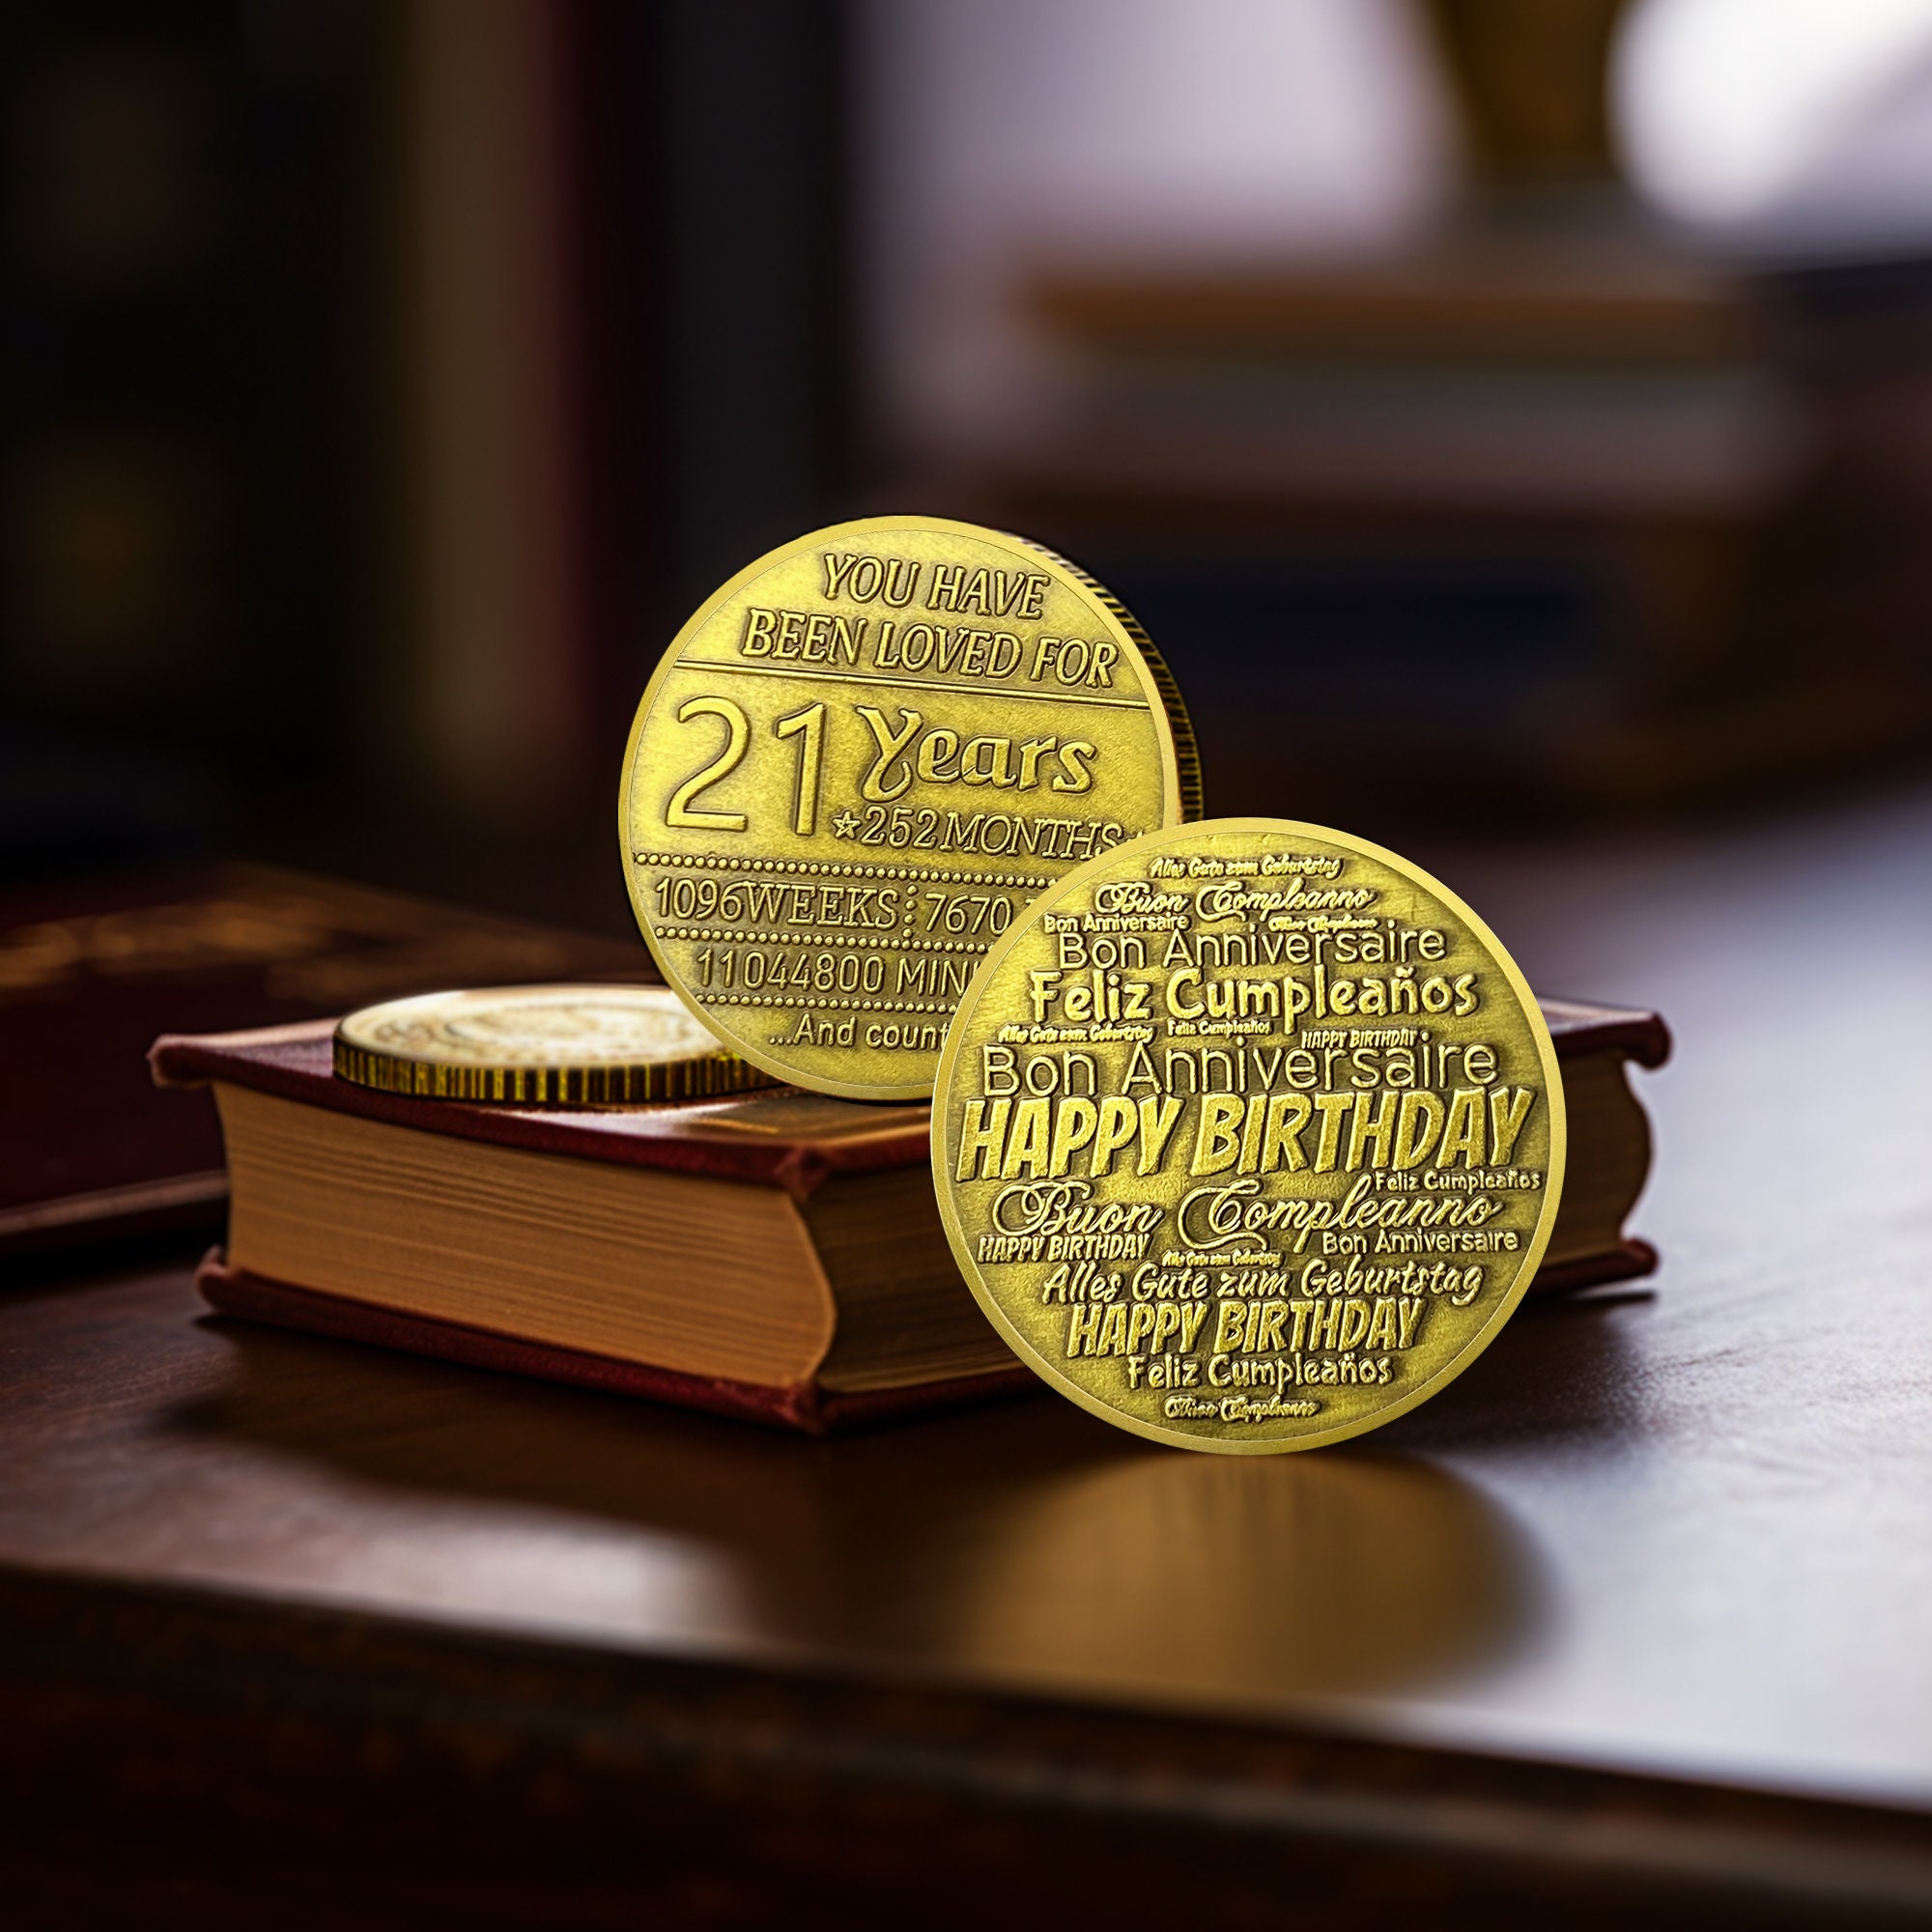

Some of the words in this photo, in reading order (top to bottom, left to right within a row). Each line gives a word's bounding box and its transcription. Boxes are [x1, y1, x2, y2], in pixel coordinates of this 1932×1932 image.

[824, 554, 921, 607] YOU
[928, 565, 1050, 619] HAVE
[743, 609, 867, 667] BEEN
[875, 623, 1025, 679] LOVED
[1030, 638, 1120, 689] FOR
[667, 695, 826, 837] 21
[856, 705, 1095, 802] Years
[925, 893, 1010, 935] 7670
[1043, 914, 1077, 933] Bon
[1083, 912, 1190, 933] Anniversaire
[1095, 881, 1189, 914] Buon
[1195, 877, 1376, 922] Compleanno
[1059, 932, 1146, 970] Bon
[1162, 920, 1447, 968] Anniversaire
[696, 949, 884, 993] 11044800
[896, 957, 980, 997] MIN
[1030, 968, 1152, 1023] Feliz
[1166, 964, 1478, 1035] Cumpleaños
[983, 1044, 1097, 1096] Bon
[1122, 1031, 1497, 1095] Anniversaire
[1301, 1031, 1347, 1049] HAPPY
[1350, 1028, 1418, 1048] BIRTHDAY
[956, 1094, 1184, 1181] HAPPY
[1190, 1086, 1535, 1177] BIRTHDAY
[1375, 1171, 1421, 1191] Feliz
[1423, 1169, 1541, 1194] Cumpleaños
[992, 1180, 1164, 1236] Buon
[1178, 1175, 1503, 1254] Compleanno
[978, 1236, 1044, 1263] HAPPY
[1047, 1233, 1151, 1261] BIRTHDAY
[1322, 1232, 1367, 1255] Bon
[1375, 1227, 1519, 1254] Anniversaire
[1042, 1261, 1122, 1303] Alles
[1132, 1261, 1208, 1301] Gute
[1217, 1268, 1289, 1297] zum
[1301, 1254, 1485, 1305] Geburtstag
[1066, 1300, 1208, 1358] HAPPY
[1213, 1297, 1426, 1353] BIRTHDAY
[1127, 1354, 1199, 1389] Feliz
[1208, 1352, 1393, 1395] Cumpleaños
